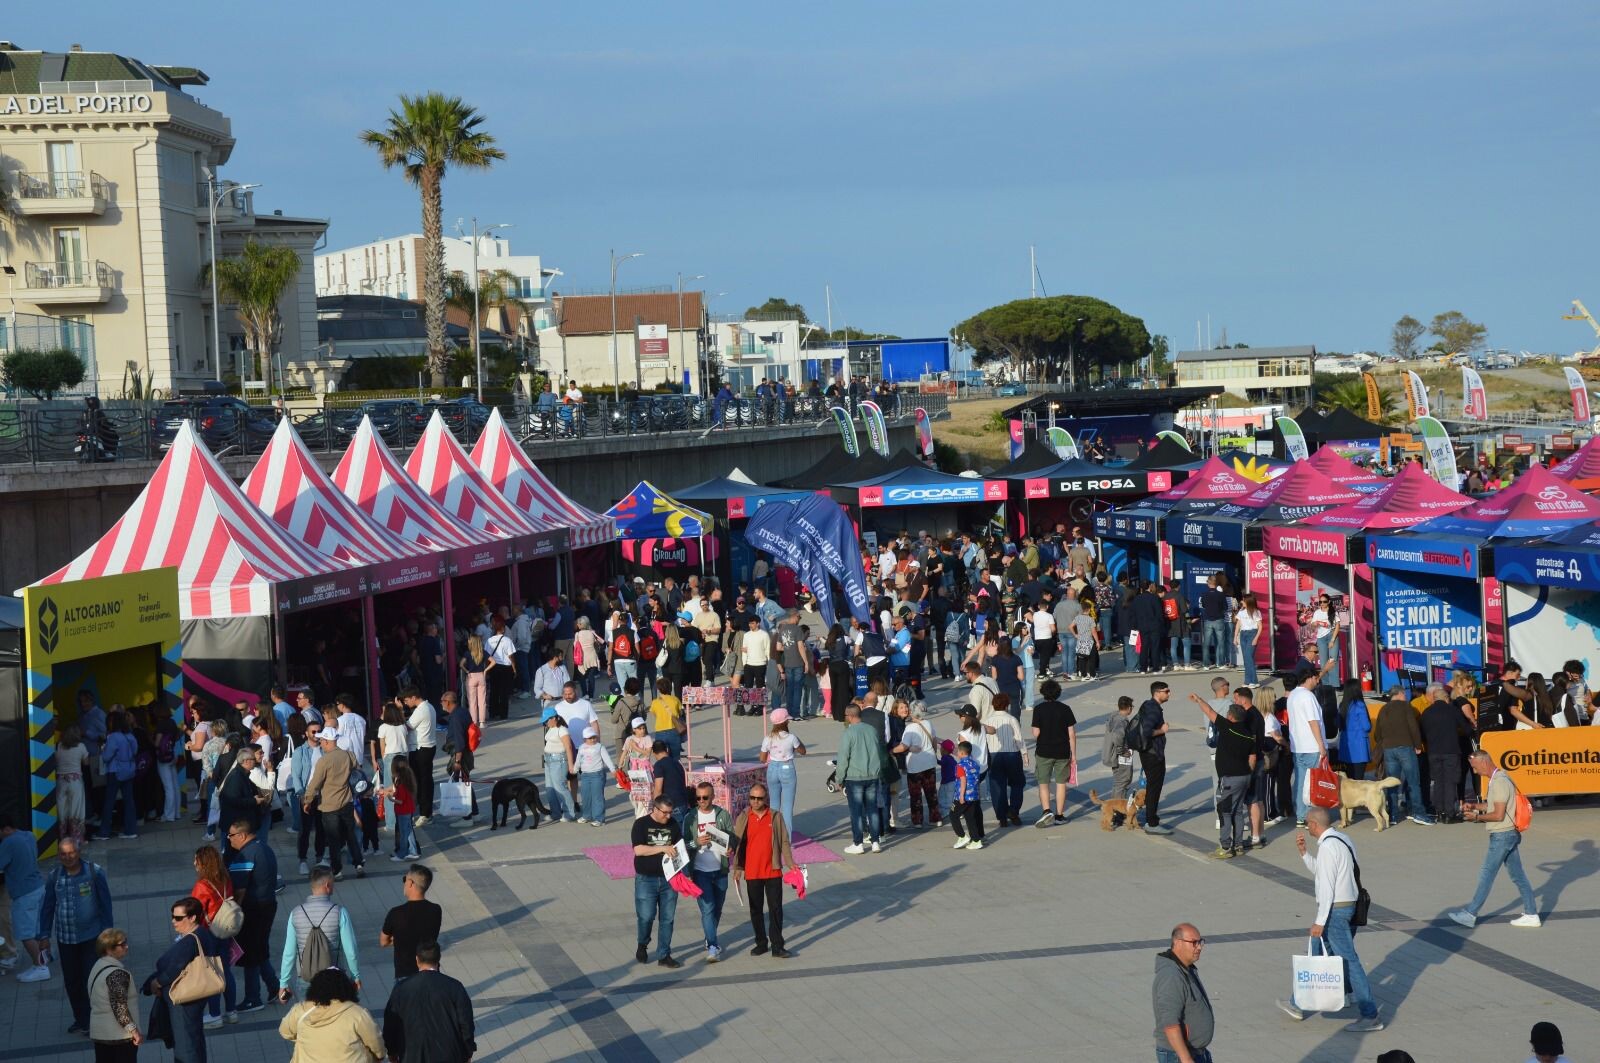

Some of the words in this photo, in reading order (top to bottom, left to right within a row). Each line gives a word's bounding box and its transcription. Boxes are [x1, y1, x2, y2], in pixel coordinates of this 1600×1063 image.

[26, 95, 71, 114] DEL
[76, 94, 151, 113] PORTO
[1060, 481, 1082, 491] DE
[1087, 479, 1136, 490] ROSA
[1208, 483, 1223, 492] Giro
[1279, 505, 1327, 514] Cetilar
[1534, 501, 1554, 510] Giro
[1554, 500, 1586, 509] d'Italia
[1183, 522, 1203, 534] Cetilar
[1279, 535, 1303, 552] CITTÀ
[1303, 538, 1312, 553] DI
[1312, 540, 1339, 556] TAPPA
[653, 547, 686, 562] GIROLAND
[1377, 548, 1394, 560] CARTA
[1535, 557, 1565, 568] autostrade
[1536, 568, 1546, 578] per
[1386, 607, 1405, 627] SE
[1408, 605, 1440, 626] NON
[1442, 601, 1452, 624] È
[69, 625, 87, 636] cuore
[88, 622, 97, 634] del
[97, 620, 115, 632] grano
[1387, 625, 1482, 649] ELETTRONICA
